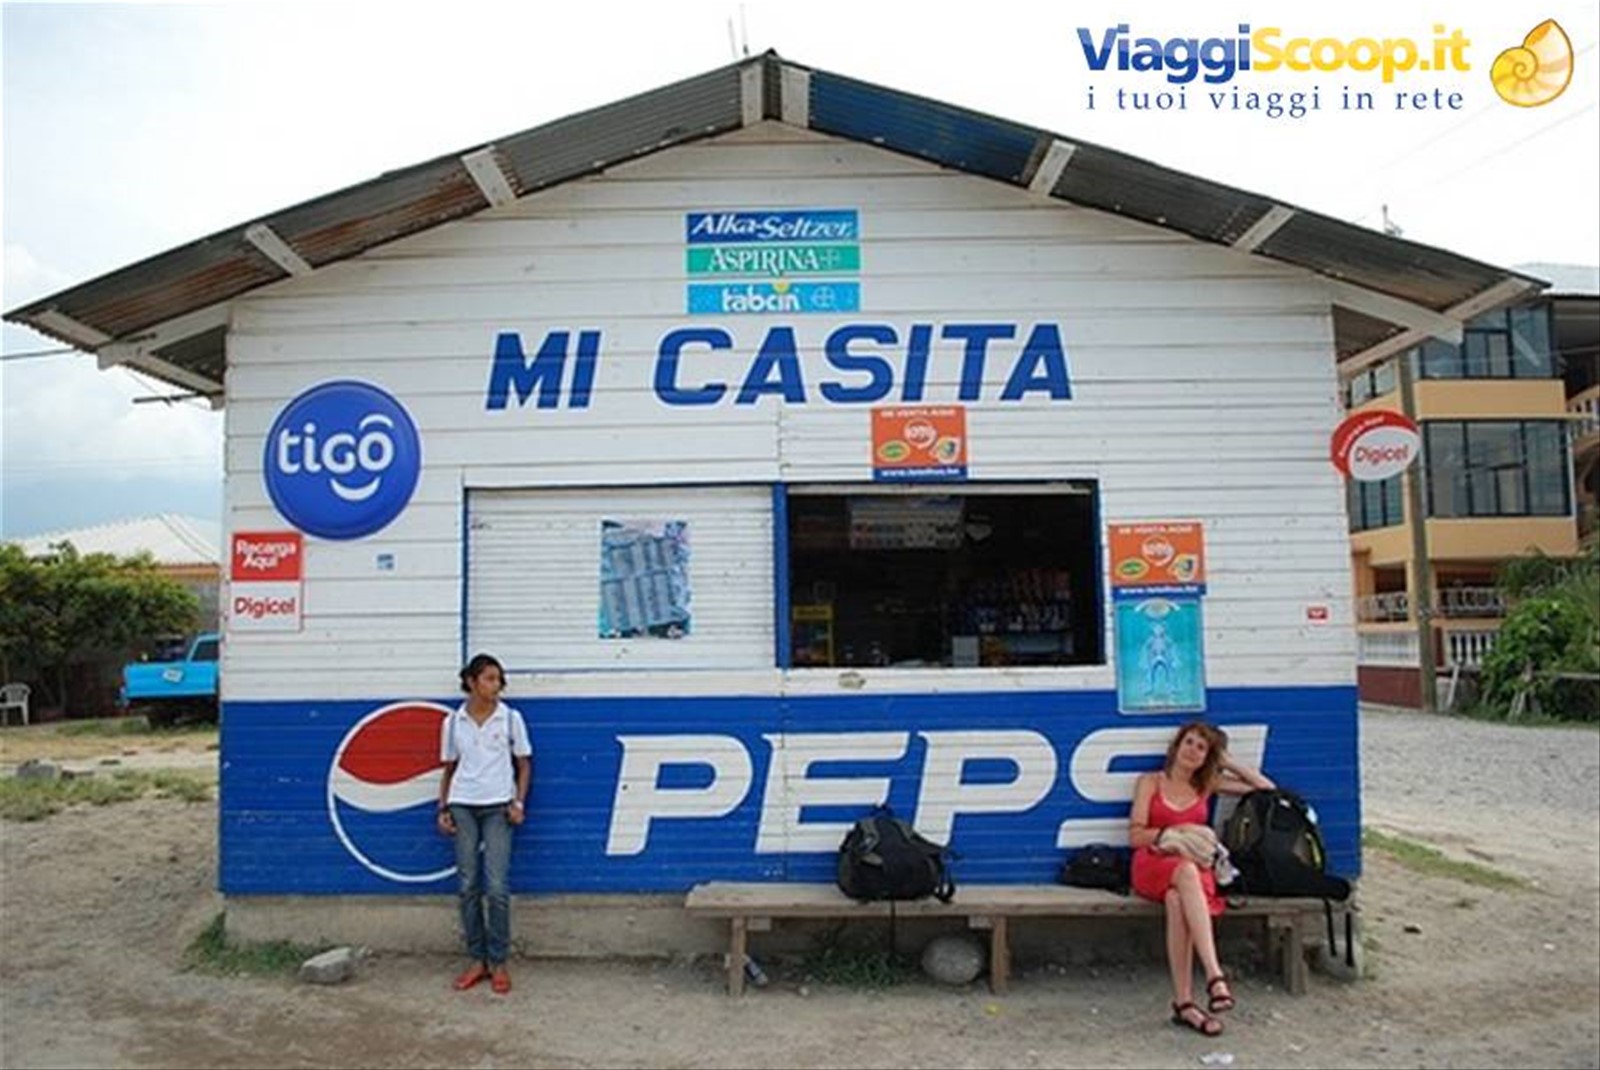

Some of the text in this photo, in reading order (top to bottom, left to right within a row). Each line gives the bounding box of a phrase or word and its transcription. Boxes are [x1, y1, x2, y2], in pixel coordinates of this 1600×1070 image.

[691, 213, 853, 239] Alka-Seltzer
[708, 248, 820, 277] ASPIRINA
[721, 282, 801, 312] tabcin
[485, 323, 1075, 410] MI CASITA
[1354, 444, 1409, 467] Digicel
[236, 539, 297, 559] Recarga
[234, 597, 296, 619] Digicel
